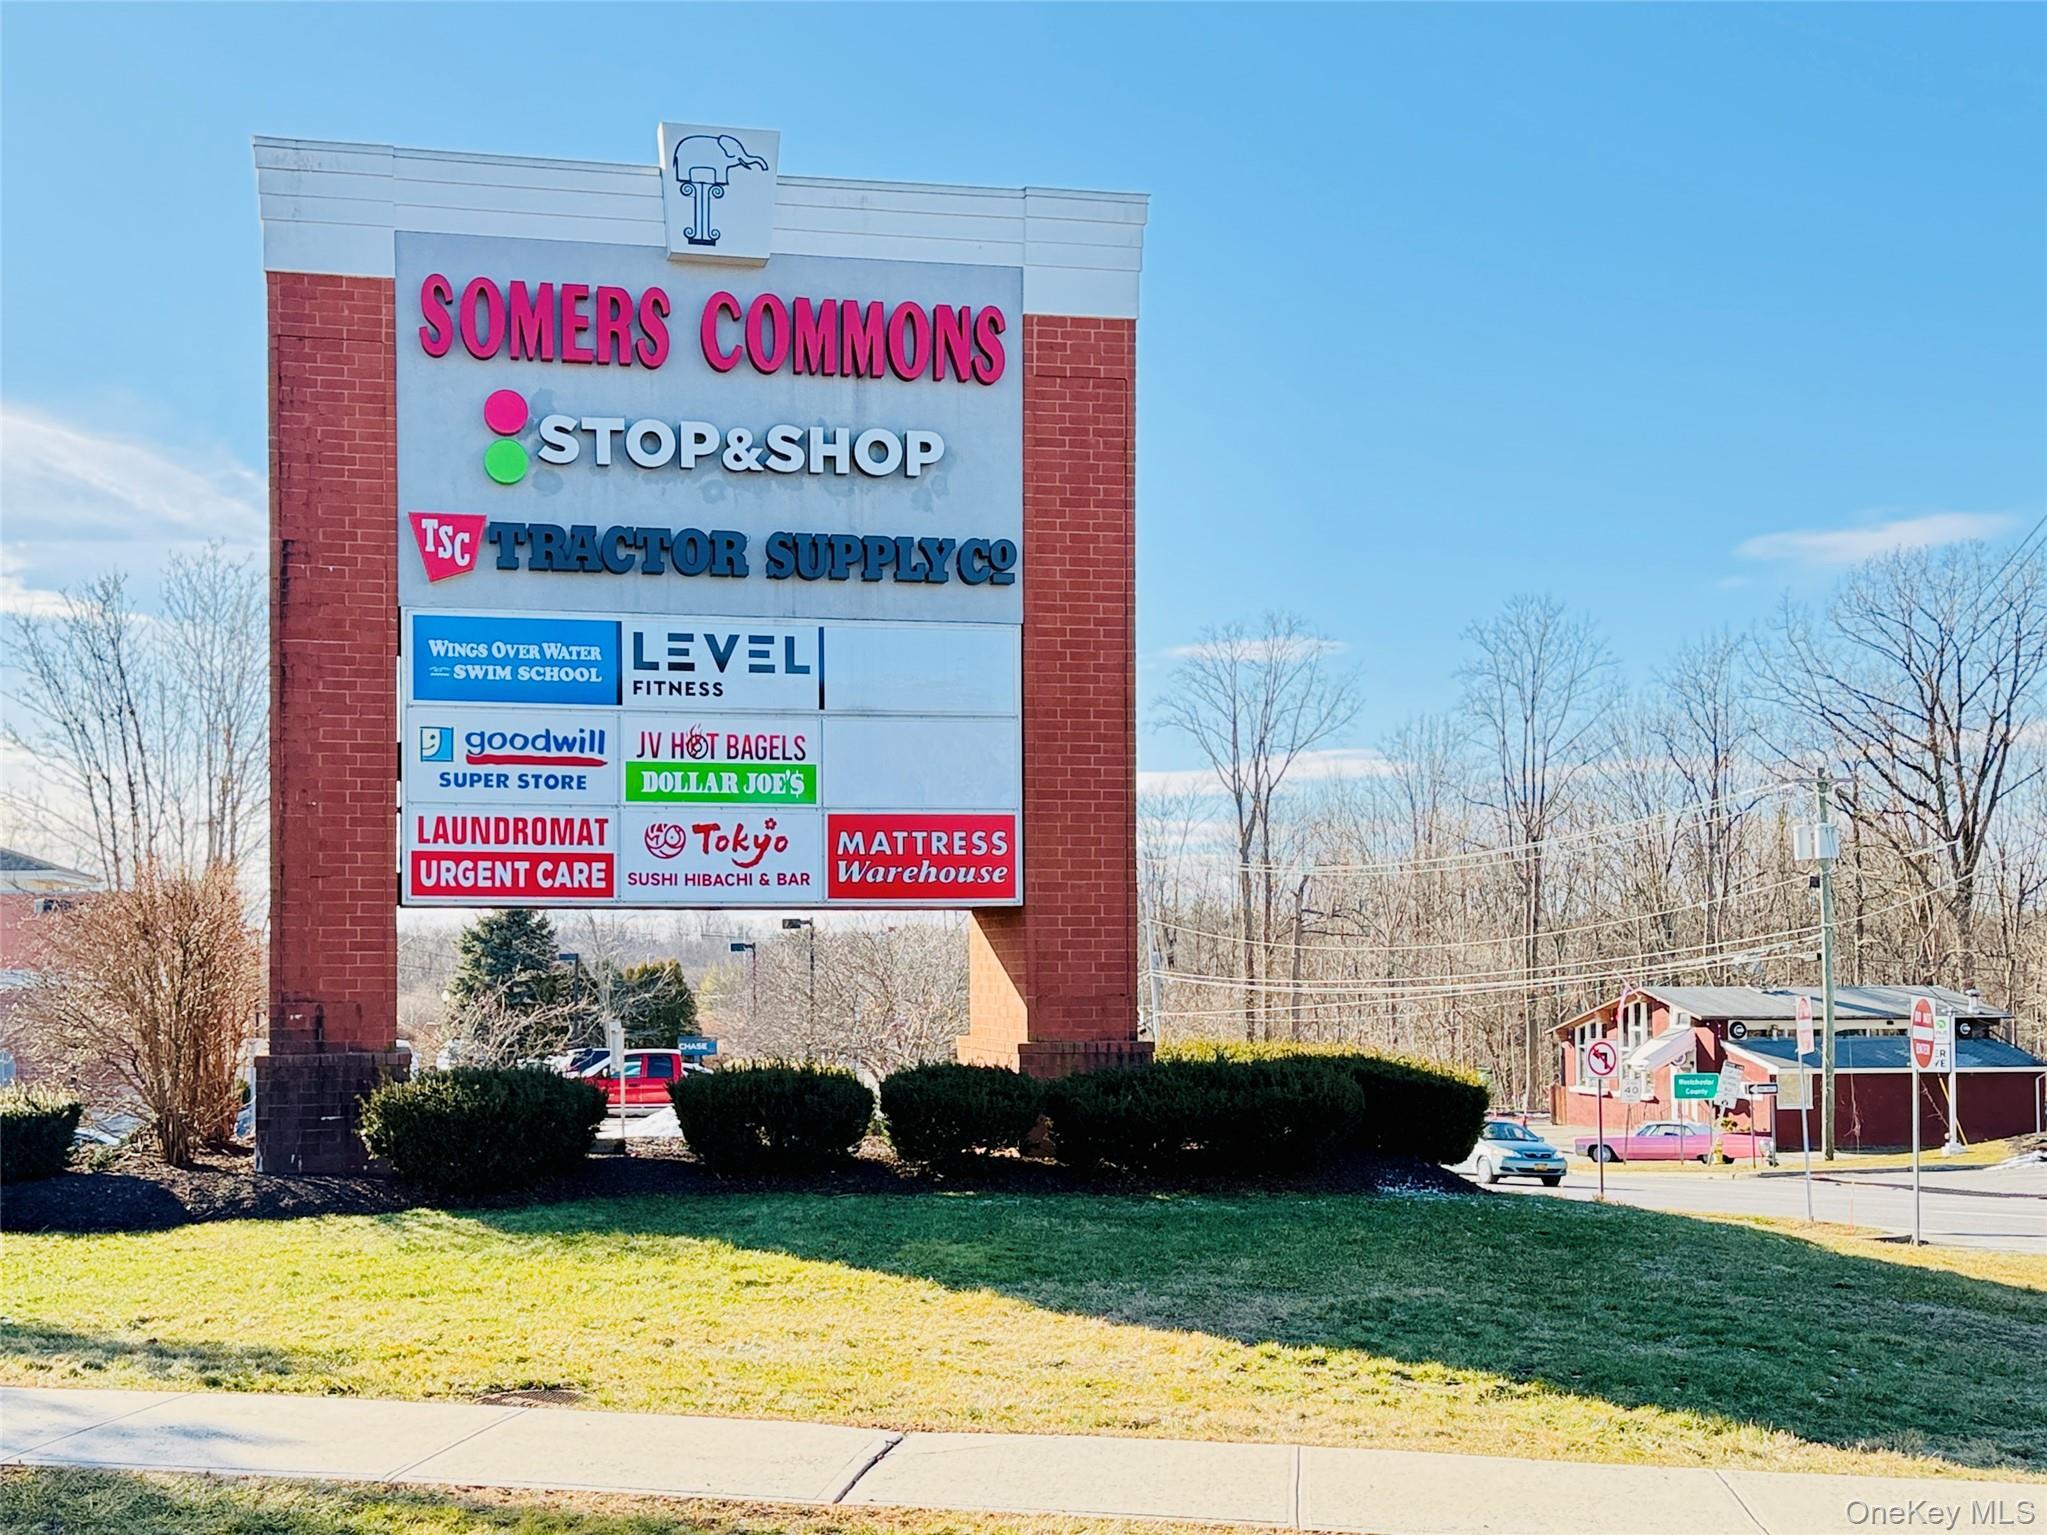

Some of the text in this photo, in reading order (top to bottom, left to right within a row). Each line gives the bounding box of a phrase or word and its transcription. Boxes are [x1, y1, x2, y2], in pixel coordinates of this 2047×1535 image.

[418, 273, 1007, 386] SOMERS COMMONS
[537, 414, 946, 478] STOP&SHOP
[421, 518, 470, 567] TSC
[489, 521, 750, 578] TRACTOR
[633, 631, 811, 675] LEVEL
[453, 664, 603, 683] SWIM SCHOOL
[633, 679, 724, 698] FITNESS
[464, 727, 606, 756] goodwill
[636, 731, 662, 759] JV
[726, 733, 807, 761] BAGELS
[439, 771, 587, 790] SUPER STORE
[641, 770, 739, 794] DOLLAR
[417, 815, 609, 846] LAUNDROMAT
[691, 821, 789, 869] Tokyo
[837, 831, 1008, 856] MATTRESS
[419, 859, 607, 889] URGENT CARE
[627, 872, 811, 887] SUSHI HIBACHI & BAR
[837, 860, 1008, 884] Warehouse
[678, 1041, 708, 1050] CHASE
